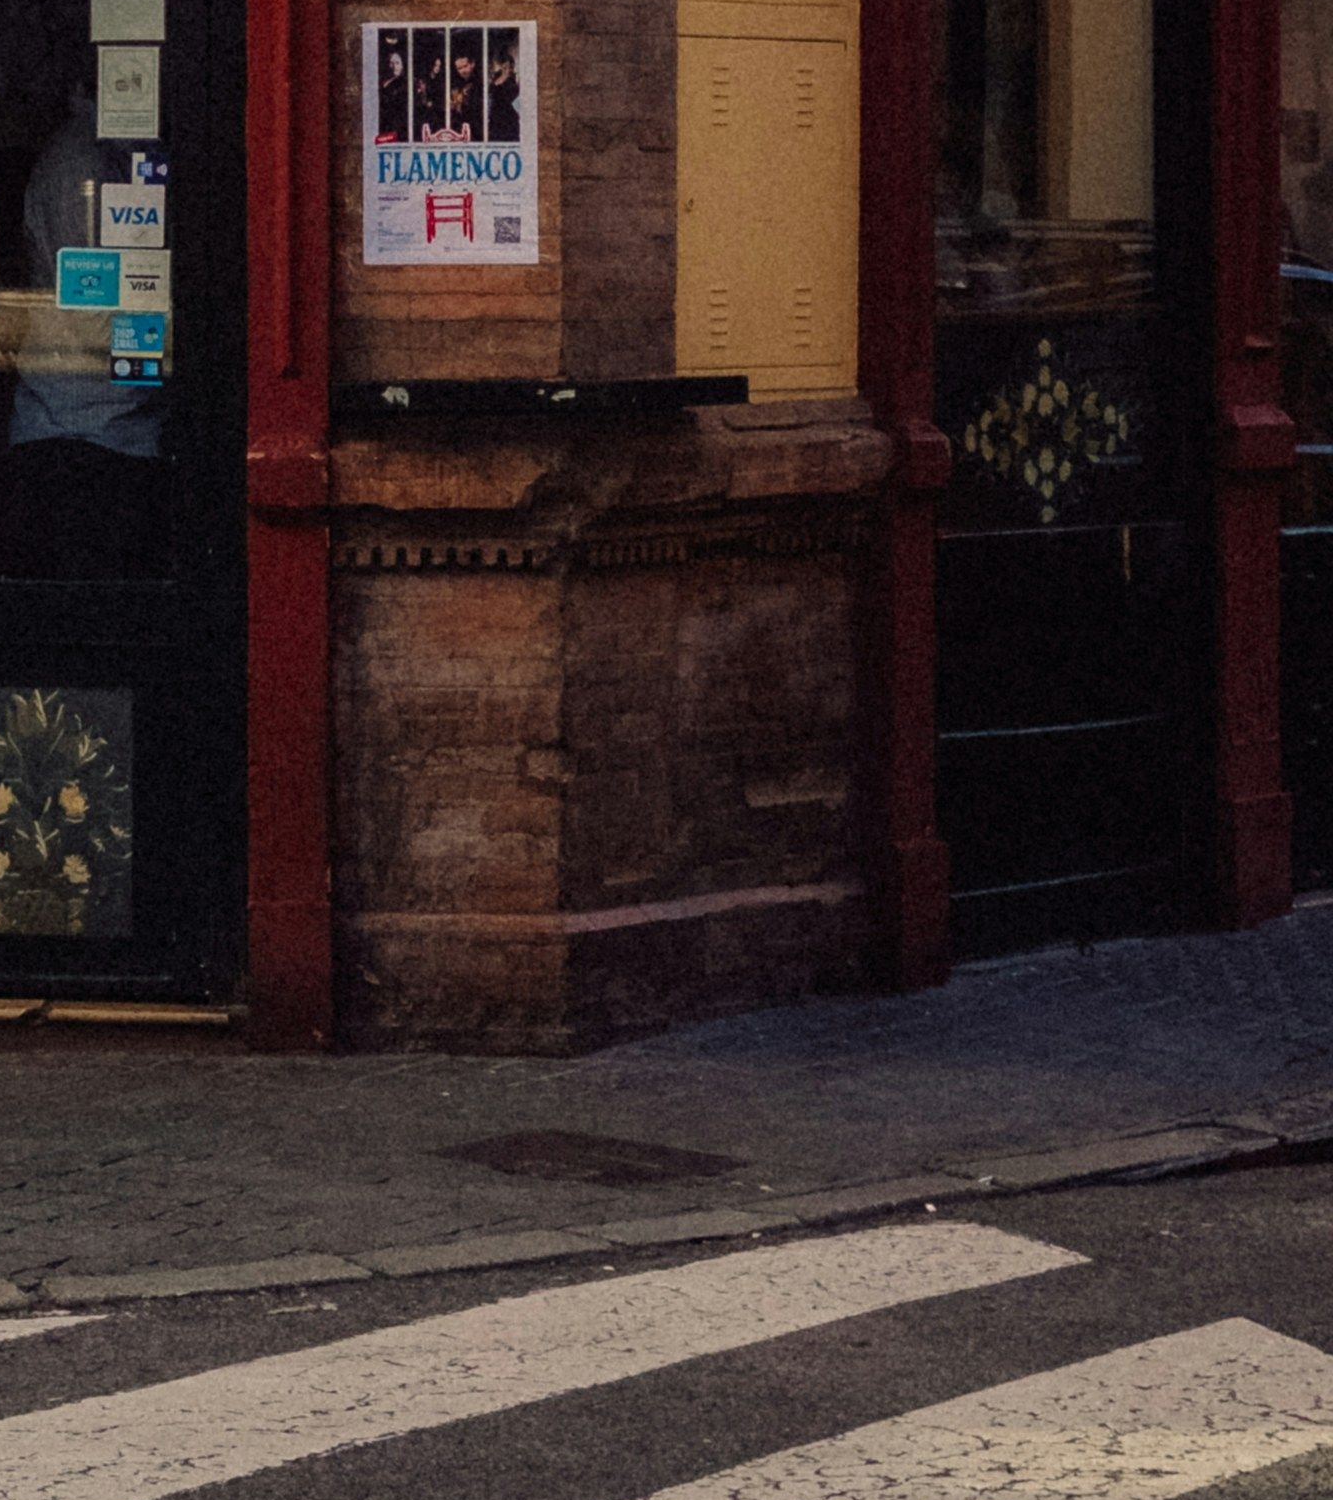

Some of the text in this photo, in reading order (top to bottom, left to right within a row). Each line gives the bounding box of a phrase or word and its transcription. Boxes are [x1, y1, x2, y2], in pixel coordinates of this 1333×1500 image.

[377, 150, 523, 184] FLAMENCO
[108, 206, 159, 225] VISA
[130, 281, 157, 292] VISA
